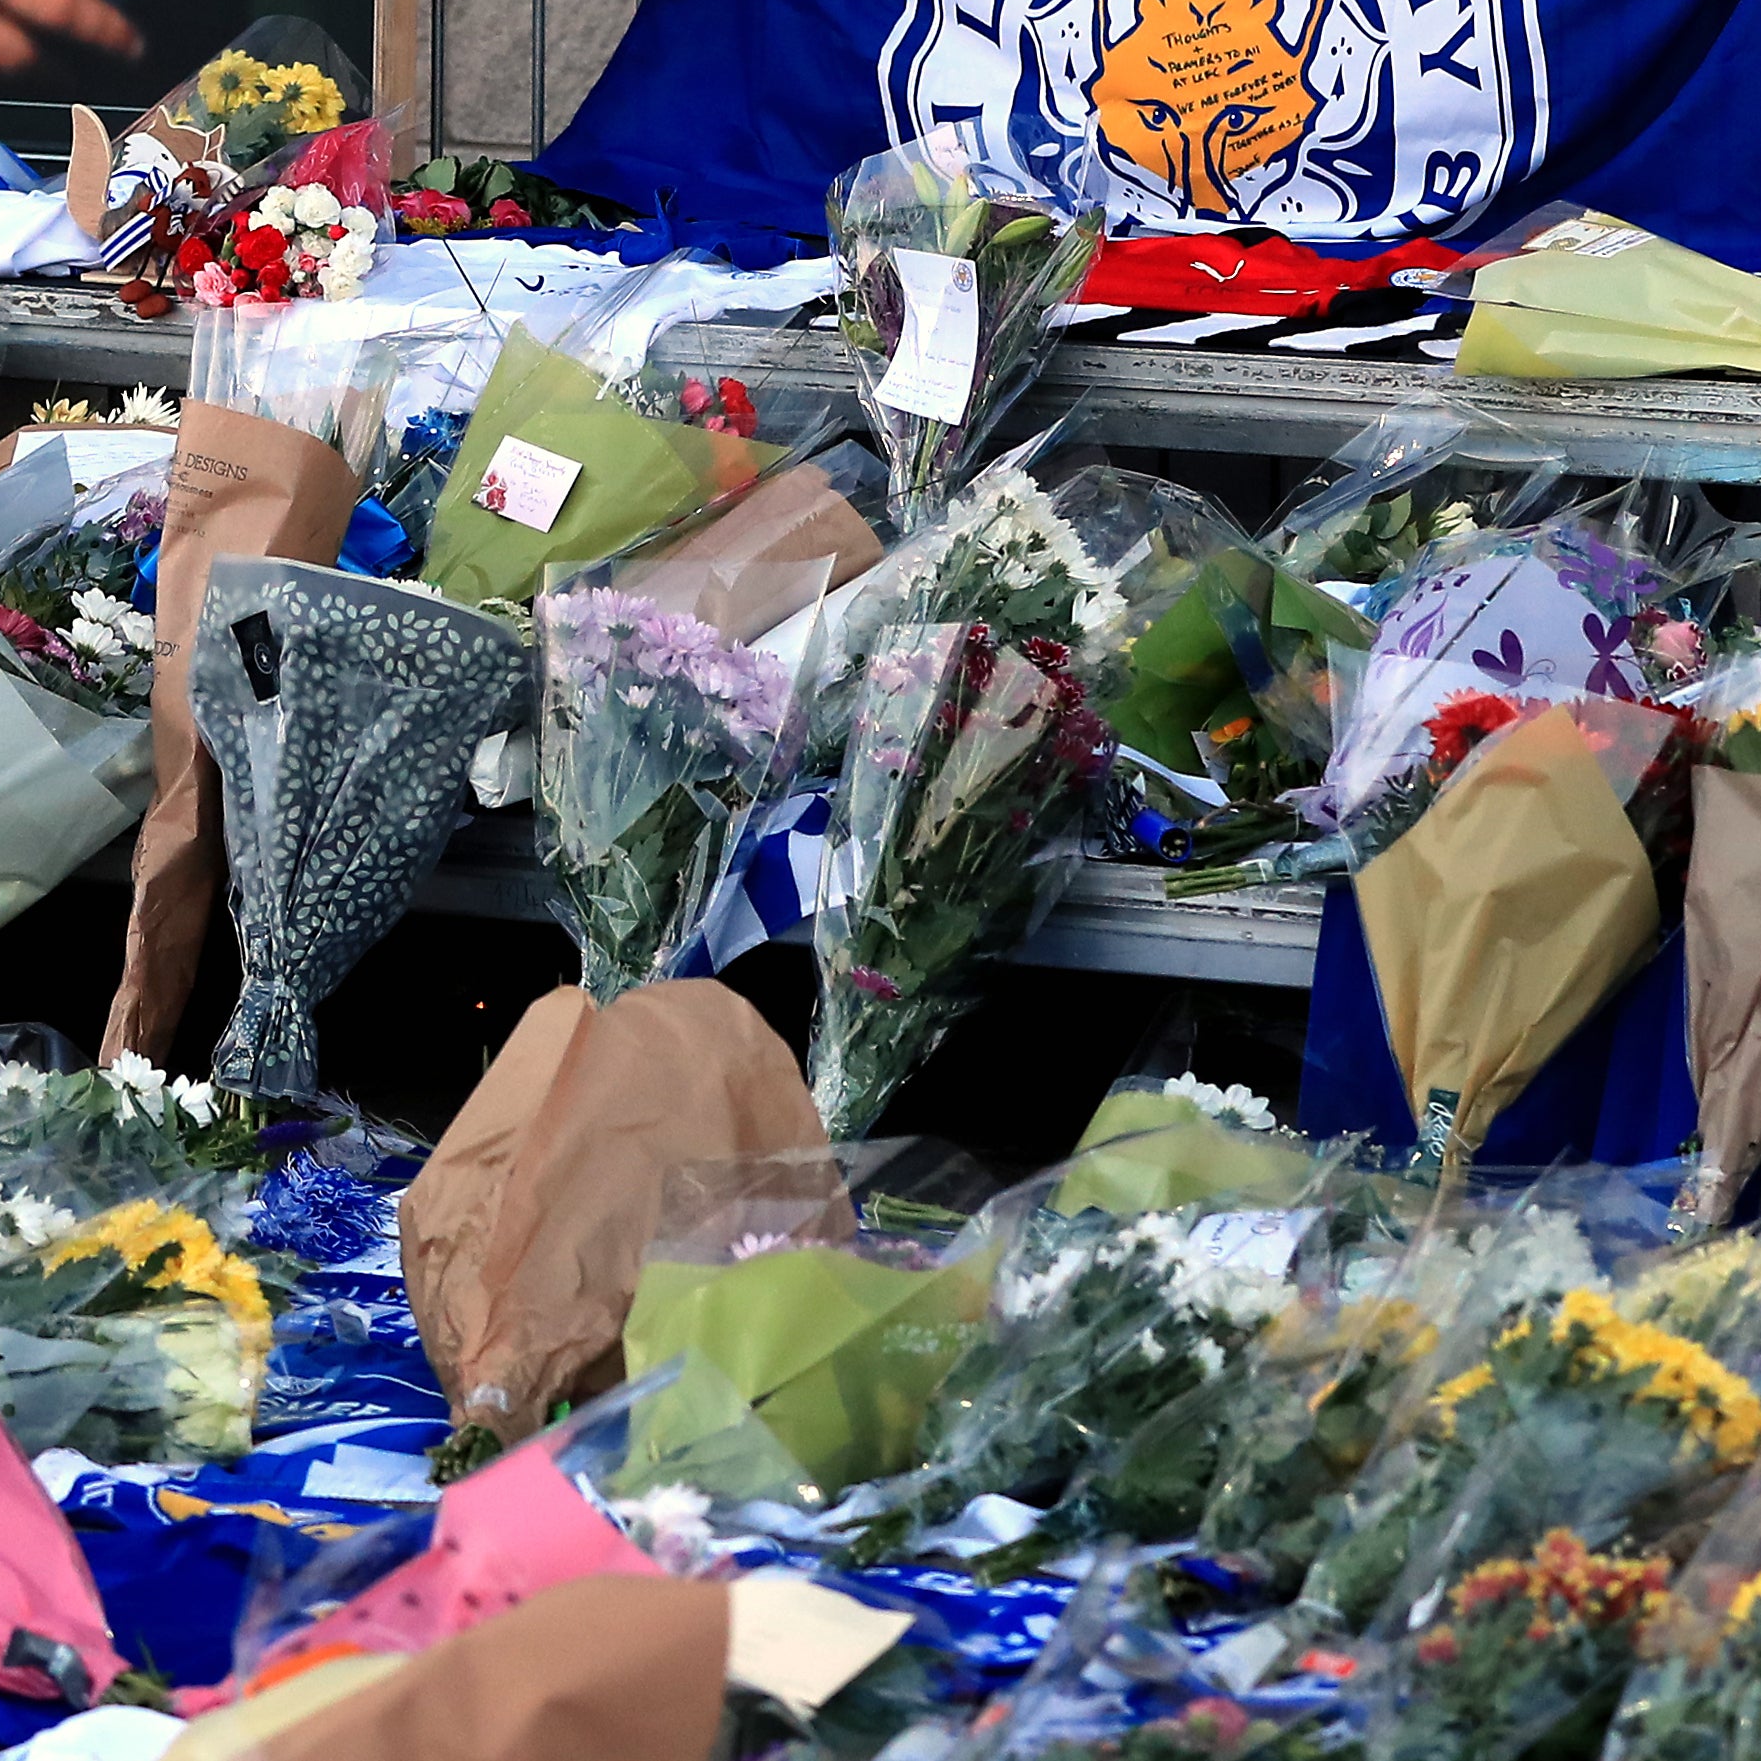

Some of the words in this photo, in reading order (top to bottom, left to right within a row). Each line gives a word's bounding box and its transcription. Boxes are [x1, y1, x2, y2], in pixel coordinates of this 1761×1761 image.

[1162, 23, 1232, 48] THOUGHTS
[1168, 53, 1222, 73] PRAYERS
[1224, 50, 1241, 60] TO
[1172, 77, 1187, 89] AT
[1176, 102, 1194, 116] WE
[1201, 95, 1219, 108] ARE
[1223, 74, 1269, 101] FOREVER
[1272, 73, 1298, 93] DEBT
[1227, 124, 1276, 152] TOGETHER
[185, 453, 249, 482] DESIGNS
